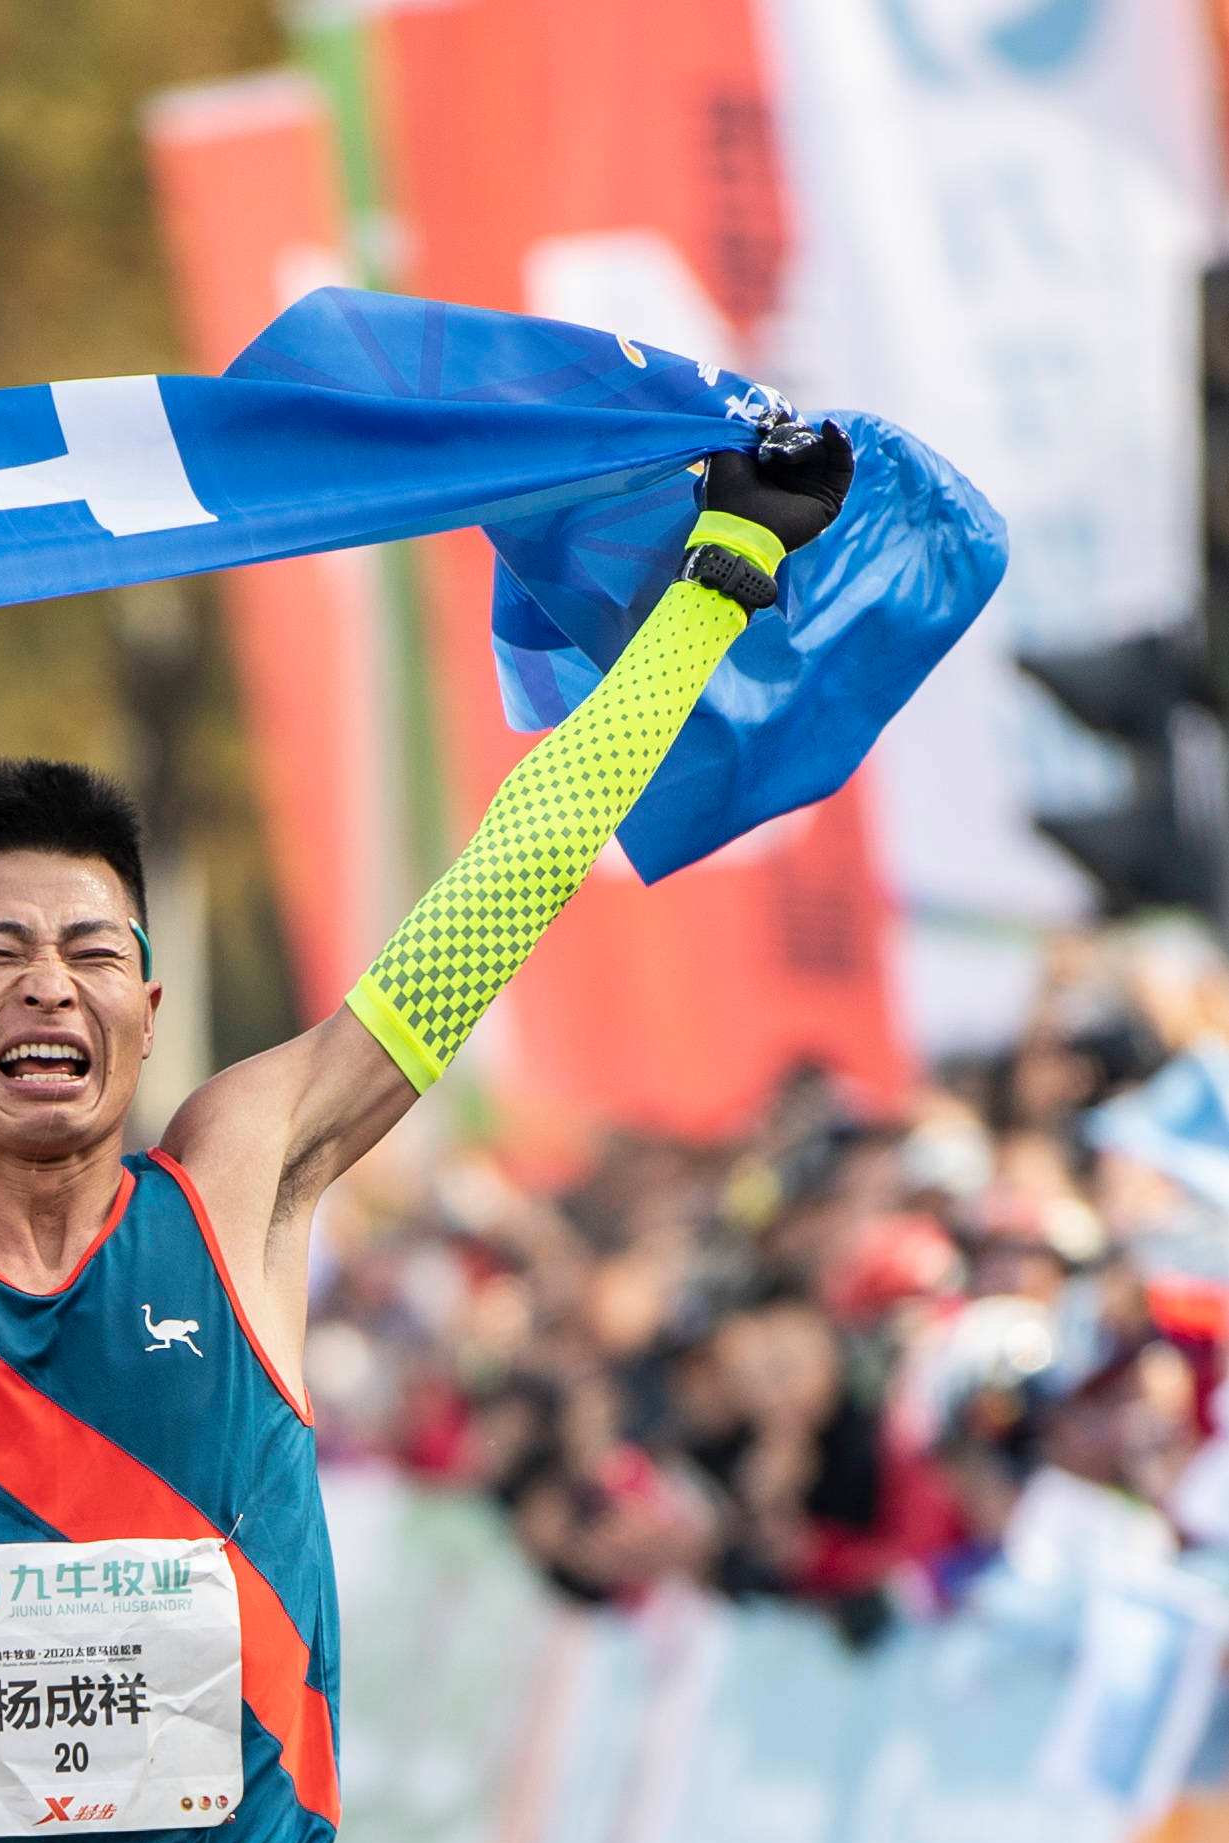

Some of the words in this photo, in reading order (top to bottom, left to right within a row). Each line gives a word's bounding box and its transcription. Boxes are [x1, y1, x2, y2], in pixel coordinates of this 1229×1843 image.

[10, 1559, 192, 1601] 九牛牧业
[10, 1603, 52, 1618] JIUNIU
[57, 1602, 108, 1616] ANIMAL
[113, 1599, 193, 1613] HUSBANDRY
[55, 1742, 89, 1773] 20
